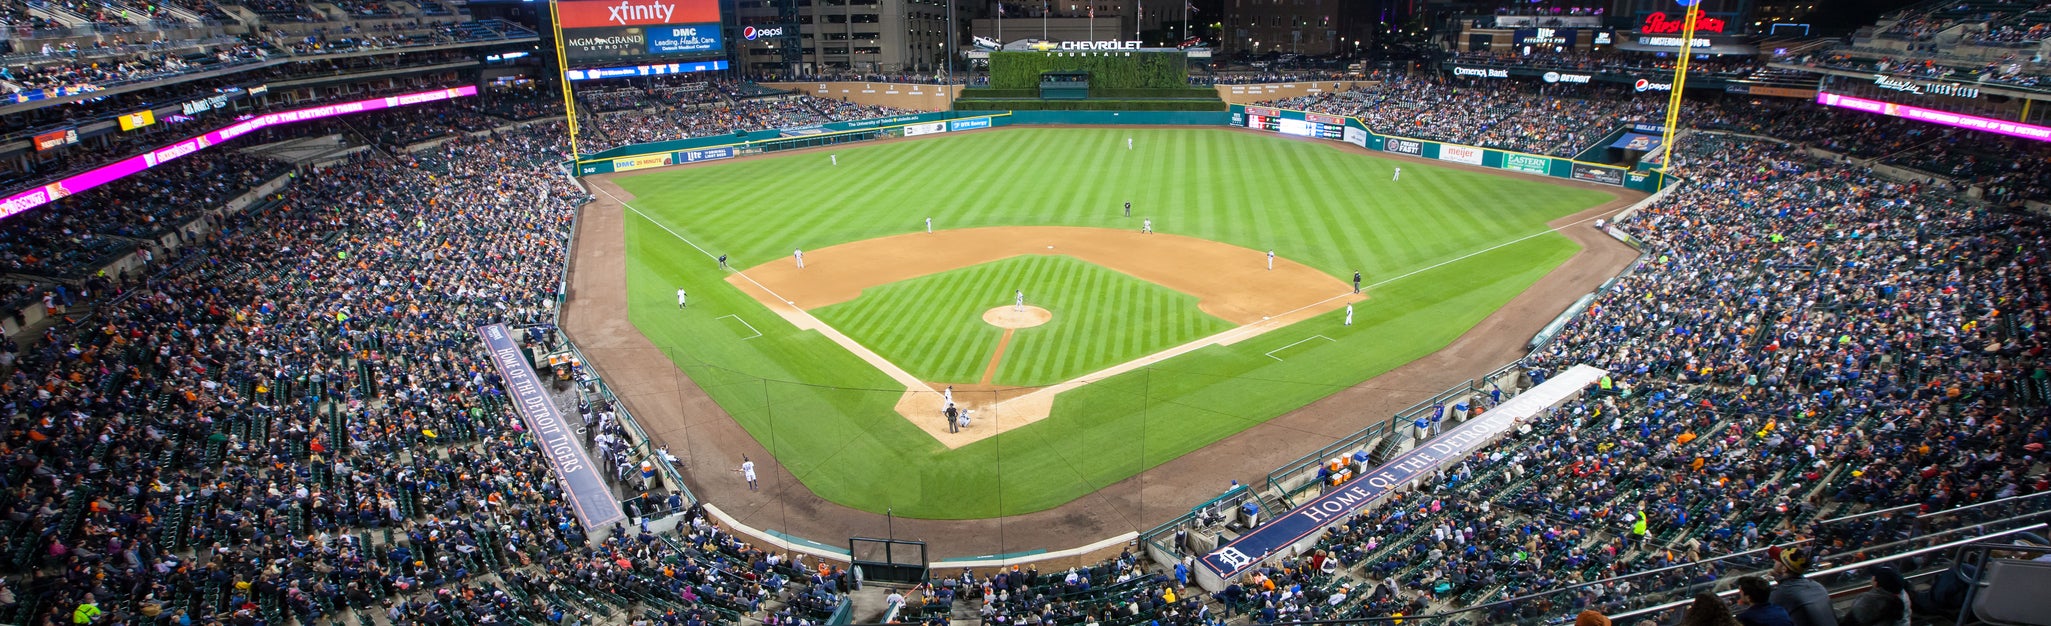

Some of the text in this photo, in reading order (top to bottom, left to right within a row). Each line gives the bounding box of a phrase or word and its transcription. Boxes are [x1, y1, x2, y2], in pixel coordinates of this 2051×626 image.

[608, 1, 675, 25] xfinity
[1642, 11, 1681, 34] Pepsi
[672, 28, 697, 37] DMC
[757, 26, 783, 38] pepsi
[1537, 28, 1556, 38] Lite
[569, 35, 641, 48] MGM GRAND
[654, 39, 680, 47] Leading.
[700, 36, 716, 44] Care.
[1061, 40, 1143, 50] CHEVROLET
[1488, 68, 1508, 78] Bank
[1559, 74, 1592, 83] DETROIT
[1648, 83, 1672, 92] pepsi
[1957, 86, 1978, 99] CLUB
[266, 114, 278, 125] OF
[279, 111, 298, 122] THE
[299, 105, 335, 118] DETROIT
[335, 102, 364, 114] TIGERS
[2015, 126, 2051, 138] DETROIT
[1399, 140, 1419, 148] FREAKY
[1399, 145, 1419, 154] FAST!
[687, 151, 702, 162] Lite
[1448, 146, 1473, 158] meijer
[615, 160, 635, 168] DMC
[643, 157, 662, 165] MINUTE
[1508, 153, 1546, 166] EASTERN
[497, 347, 583, 473] HOME OF THE DETROIT TIGERS
[1301, 486, 1370, 523] HOME
[1369, 470, 1398, 489] OF
[1394, 451, 1436, 474] THE
[1431, 413, 1506, 454] DETROIT
